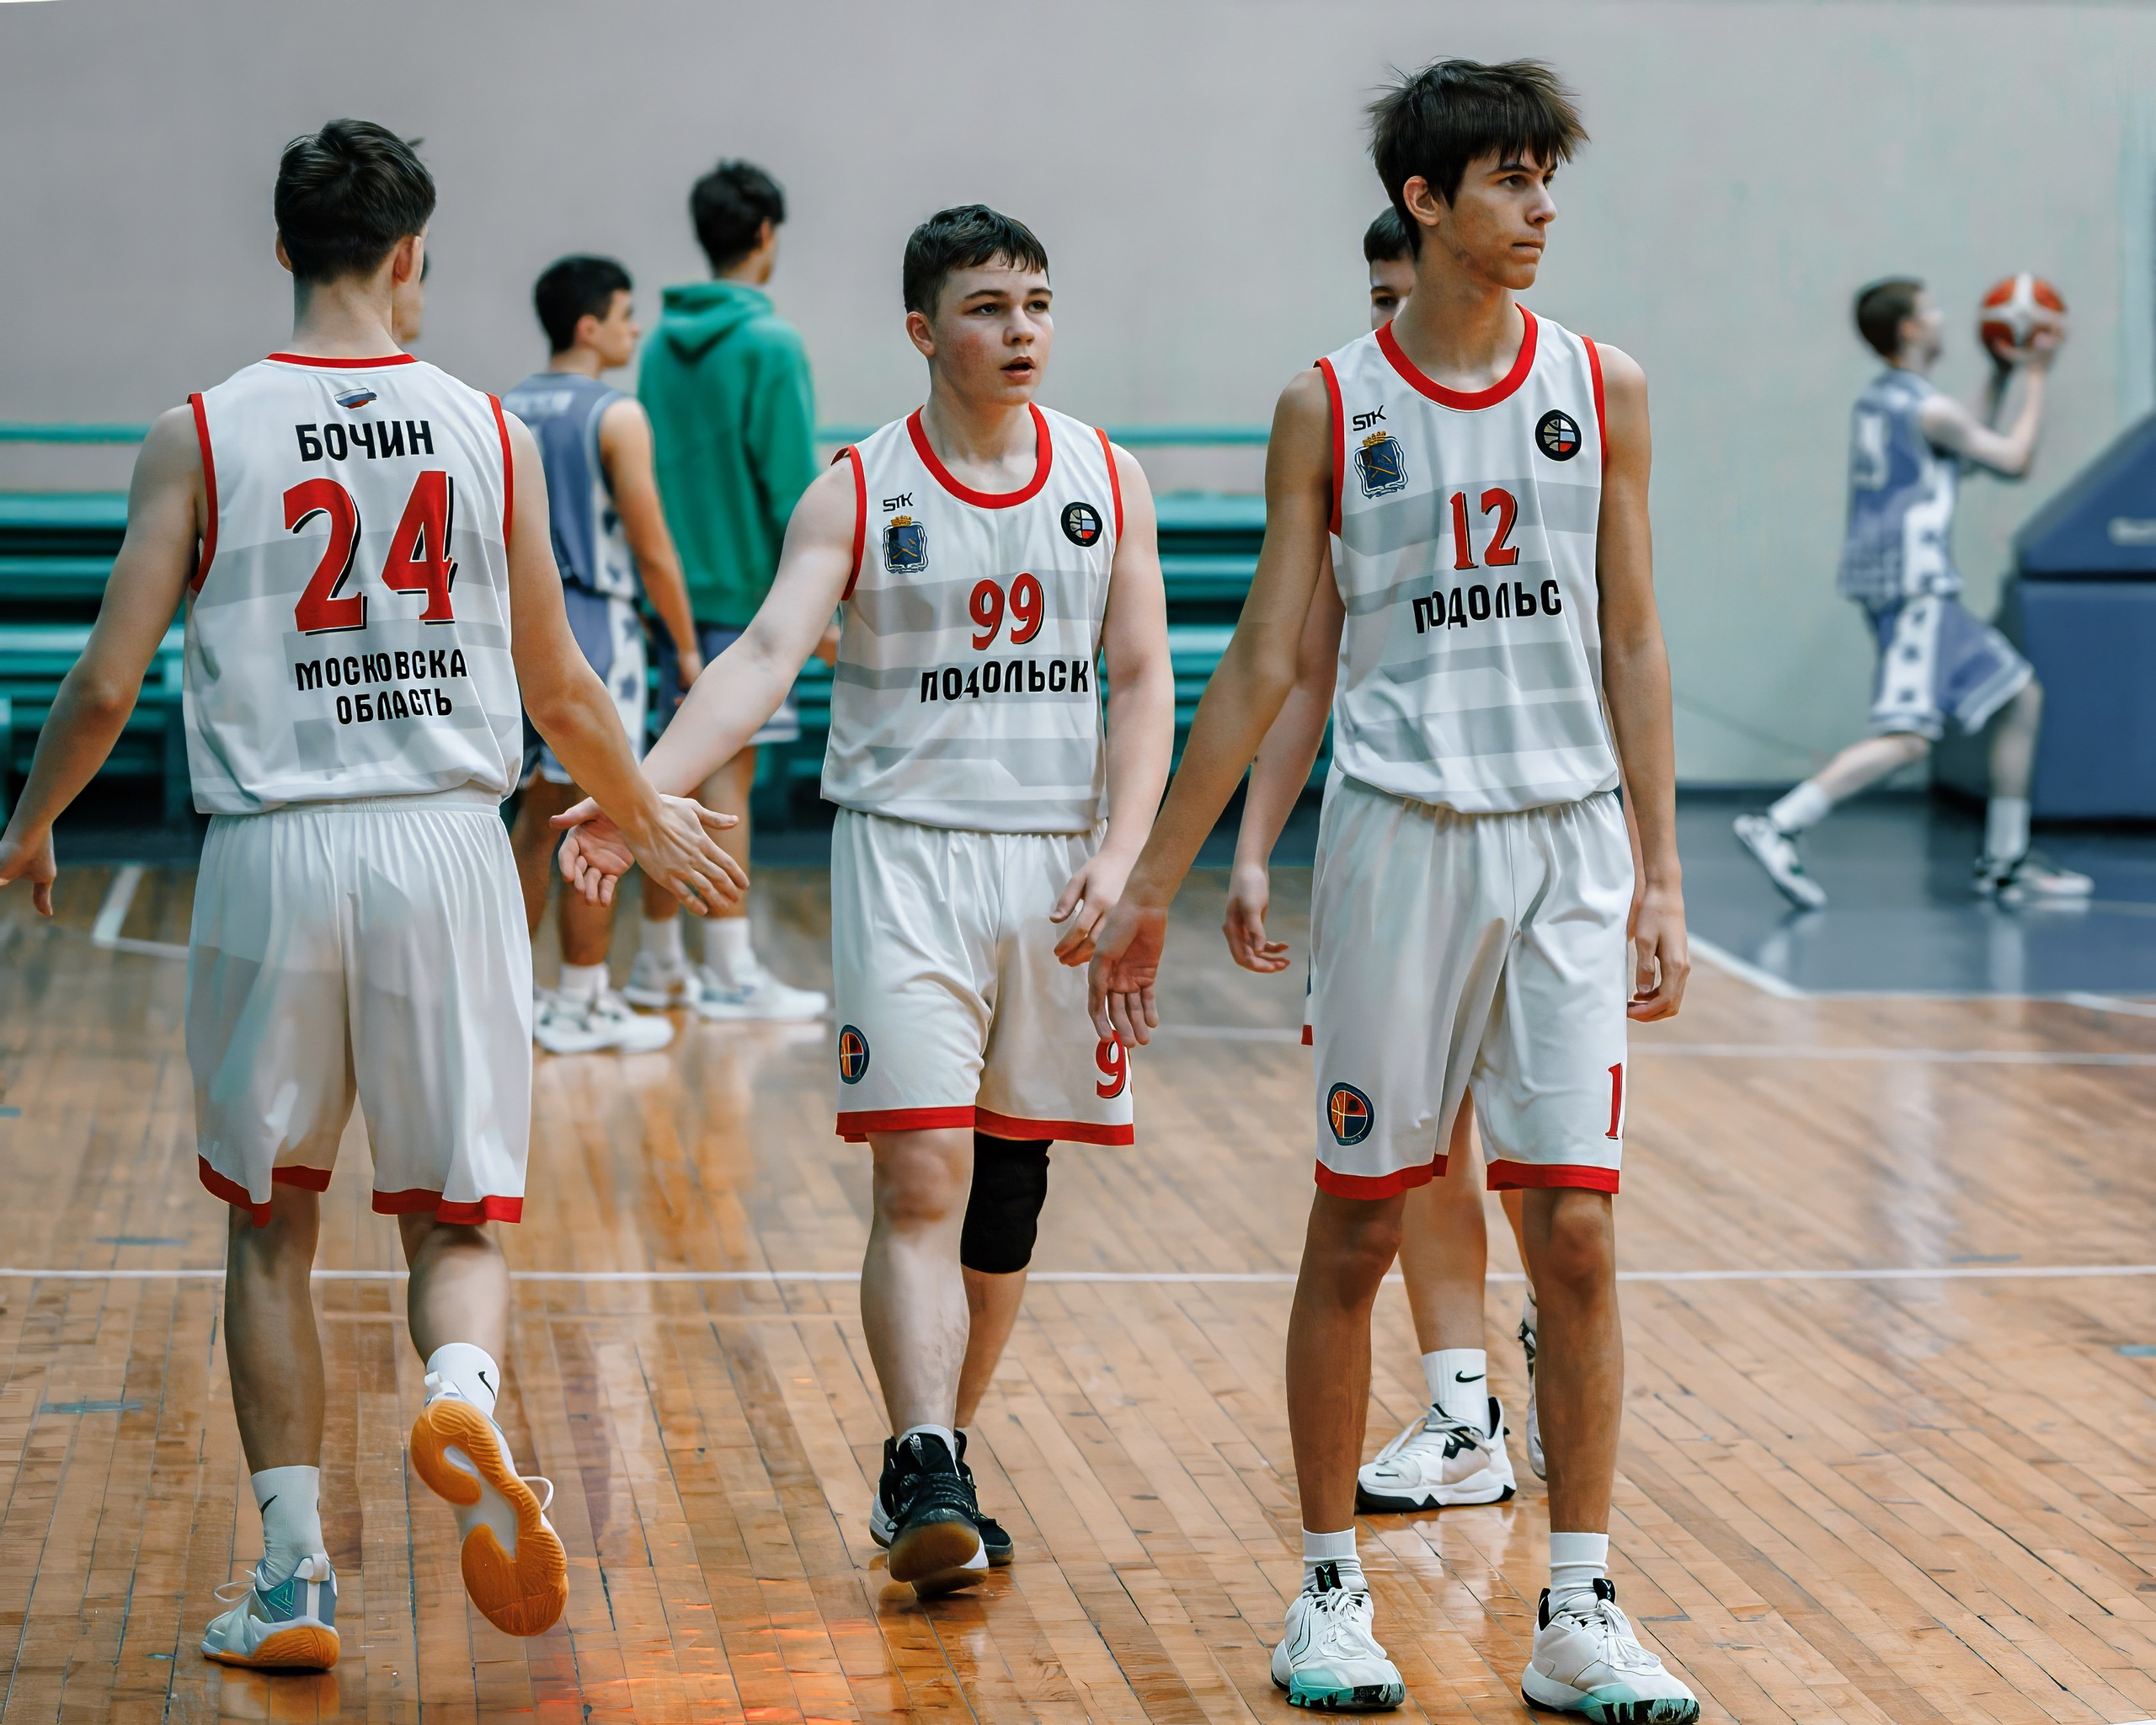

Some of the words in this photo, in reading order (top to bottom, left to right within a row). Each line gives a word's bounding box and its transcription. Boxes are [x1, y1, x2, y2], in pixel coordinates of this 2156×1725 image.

[295, 420, 435, 462] БОЧИН
[1353, 405, 1386, 431] STK
[883, 492, 914, 512] STK
[1449, 488, 1519, 570] 12
[283, 471, 458, 636] 24
[969, 573, 1044, 650] 99
[337, 688, 452, 724] ОБЛАСТЬ
[921, 660, 1089, 702] ПОДОЛЬСК
[1096, 1029, 1127, 1098] 9
[1604, 1063, 1624, 1140] 1
